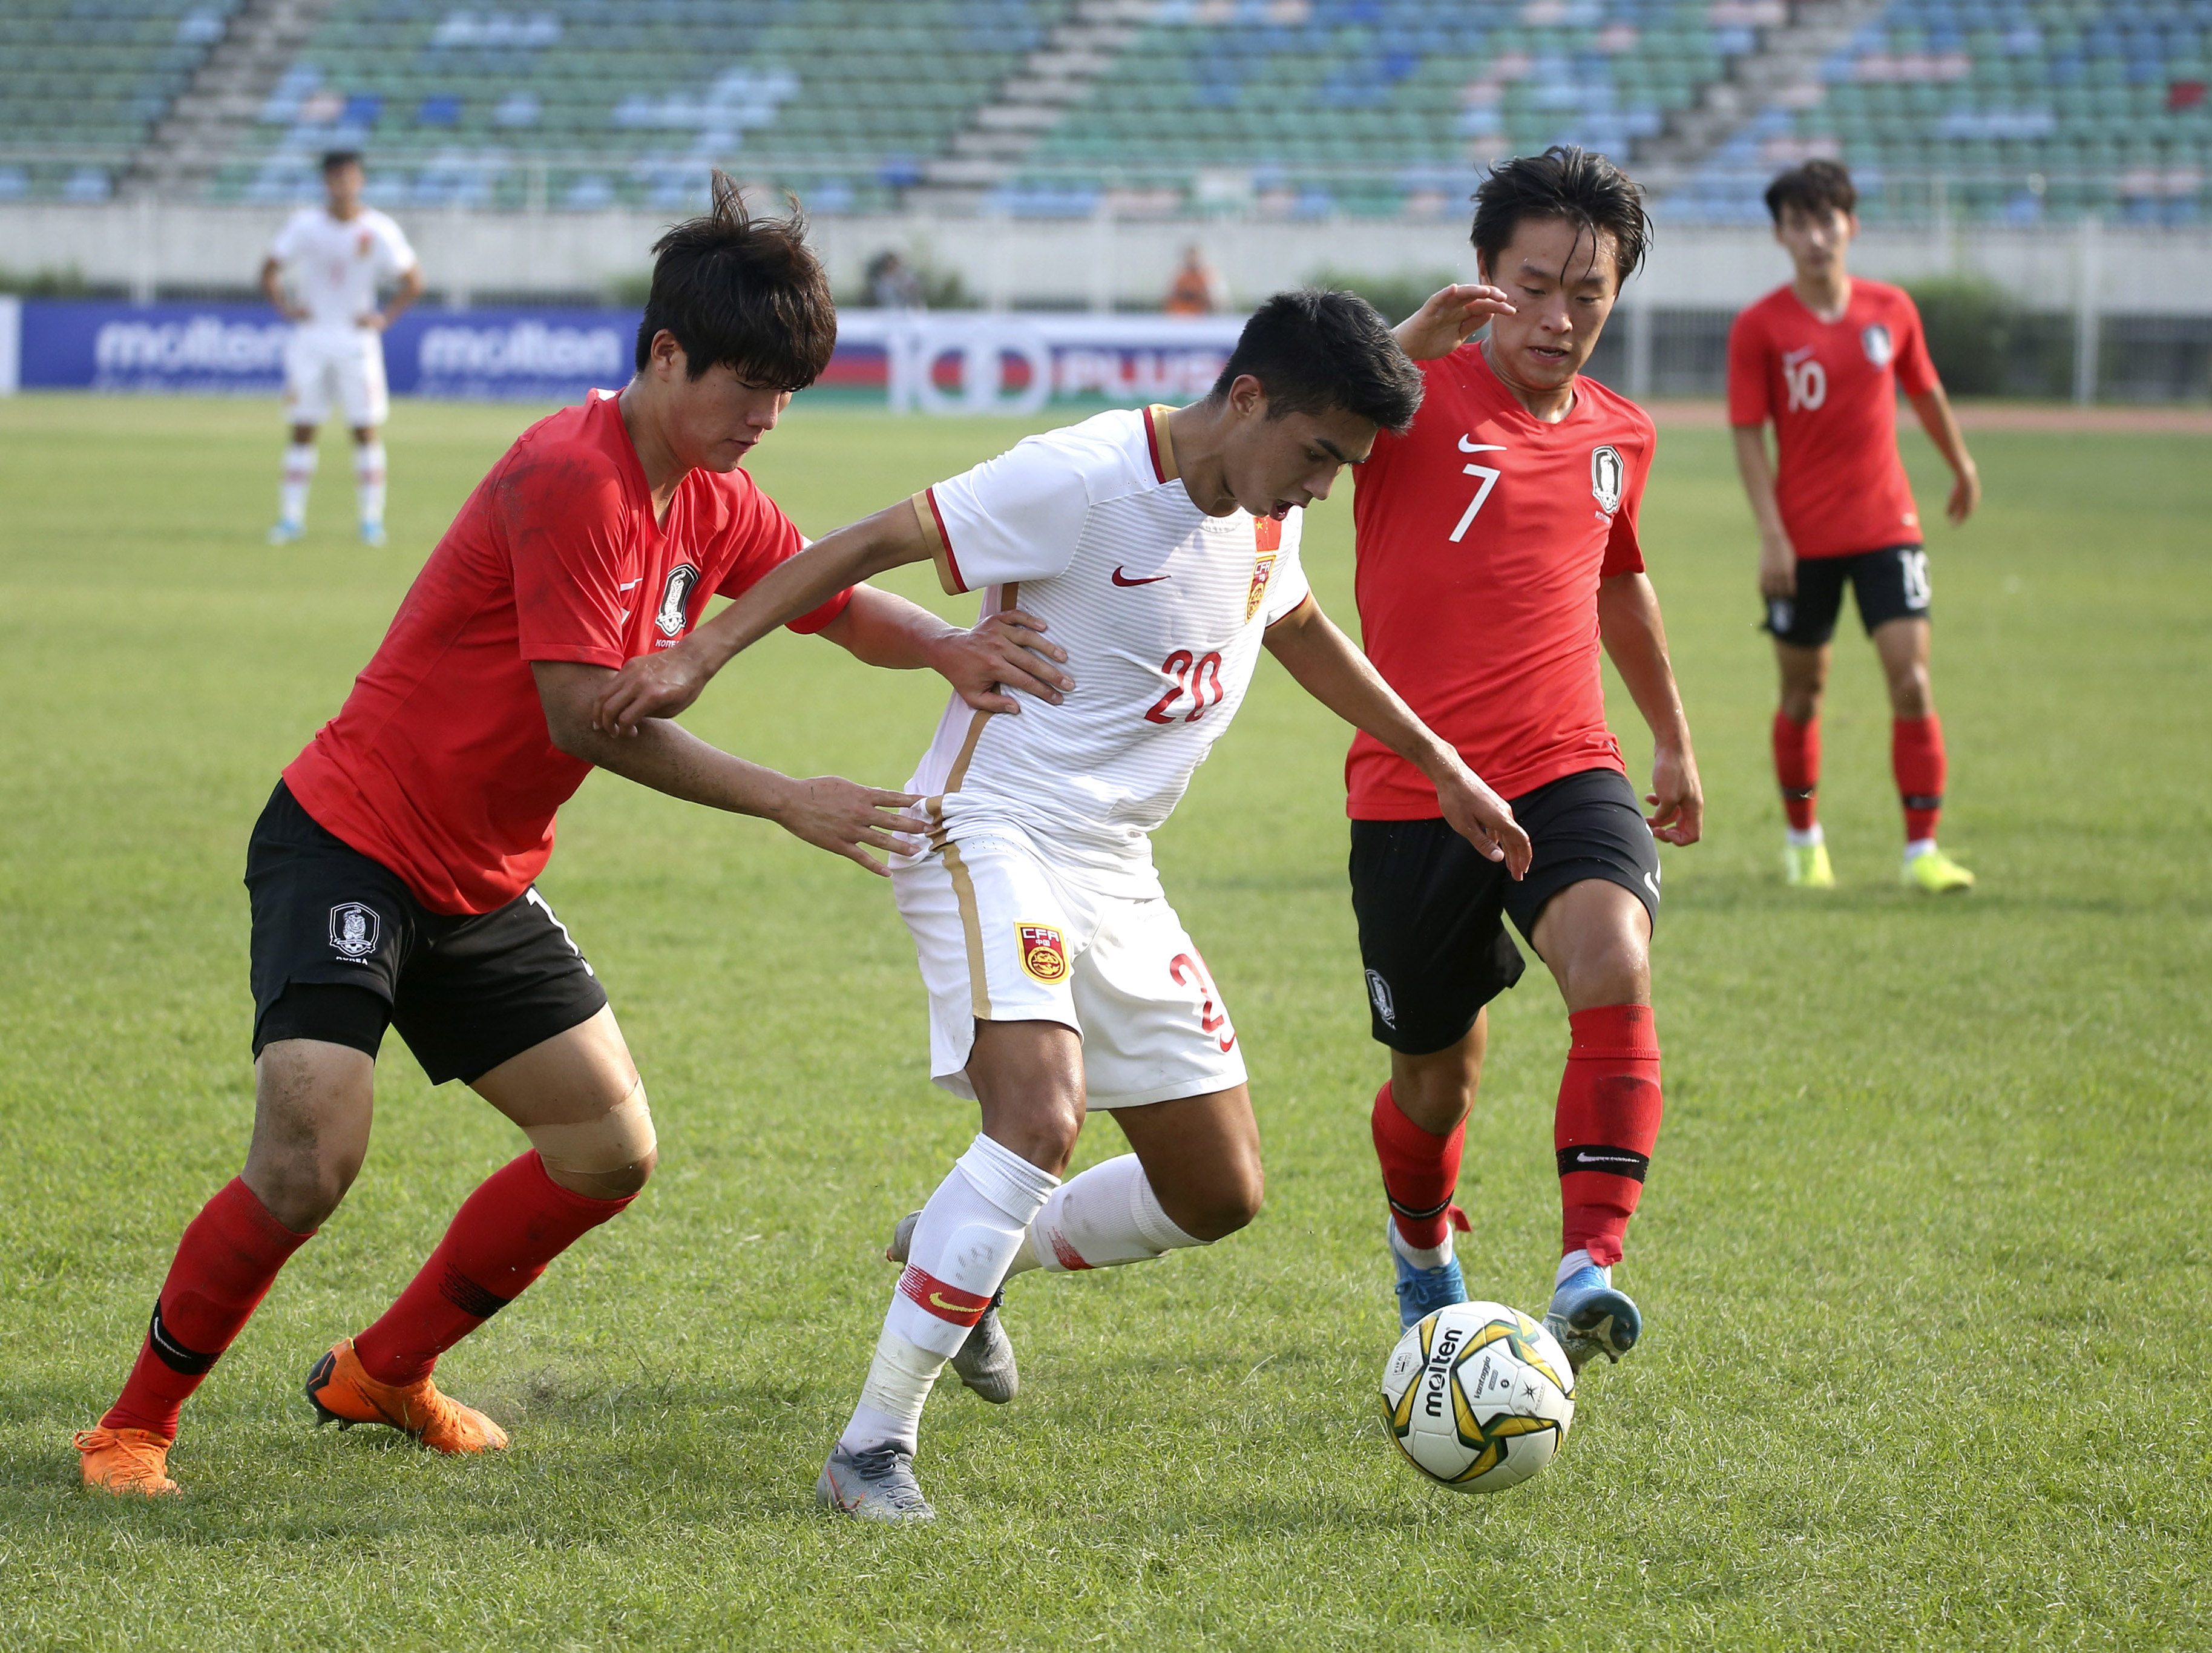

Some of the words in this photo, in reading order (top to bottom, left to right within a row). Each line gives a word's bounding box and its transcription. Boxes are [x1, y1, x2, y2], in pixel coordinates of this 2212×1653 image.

[418, 320, 622, 376] molten
[1782, 358, 1826, 413] 10
[1449, 464, 1501, 542] 7
[1255, 560, 1272, 575] CFA
[1144, 649, 1223, 724] 20
[1022, 928, 1059, 942] CFA
[1425, 1329, 1463, 1418] molten
[1474, 1356, 1491, 1399] Vantaggio
